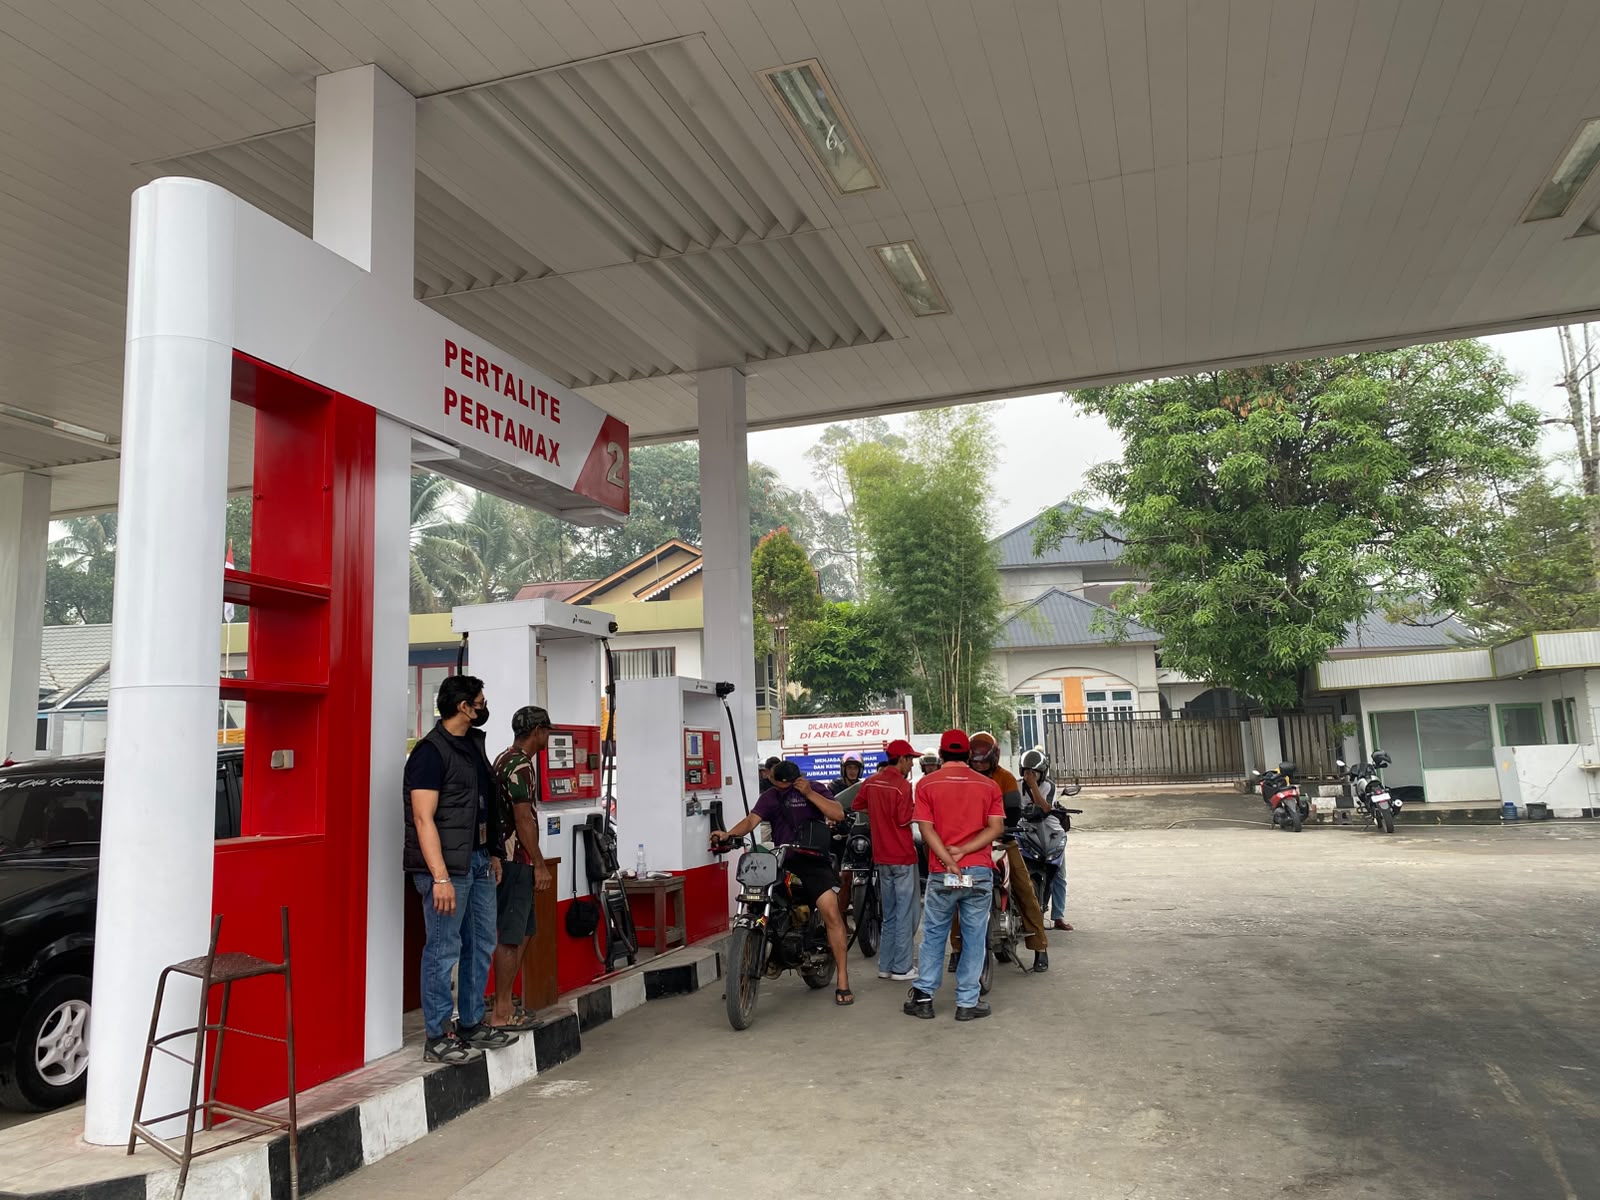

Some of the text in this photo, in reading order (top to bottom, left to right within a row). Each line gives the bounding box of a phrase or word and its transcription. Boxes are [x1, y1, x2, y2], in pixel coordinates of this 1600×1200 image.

[445, 338, 560, 424] PERTALITE
[444, 386, 560, 467] PERTAMAX
[606, 441, 625, 489] 2
[808, 720, 880, 730] DILARANG MEROKOK
[813, 730, 853, 739] AREAL
[856, 729, 890, 737] SPBU
